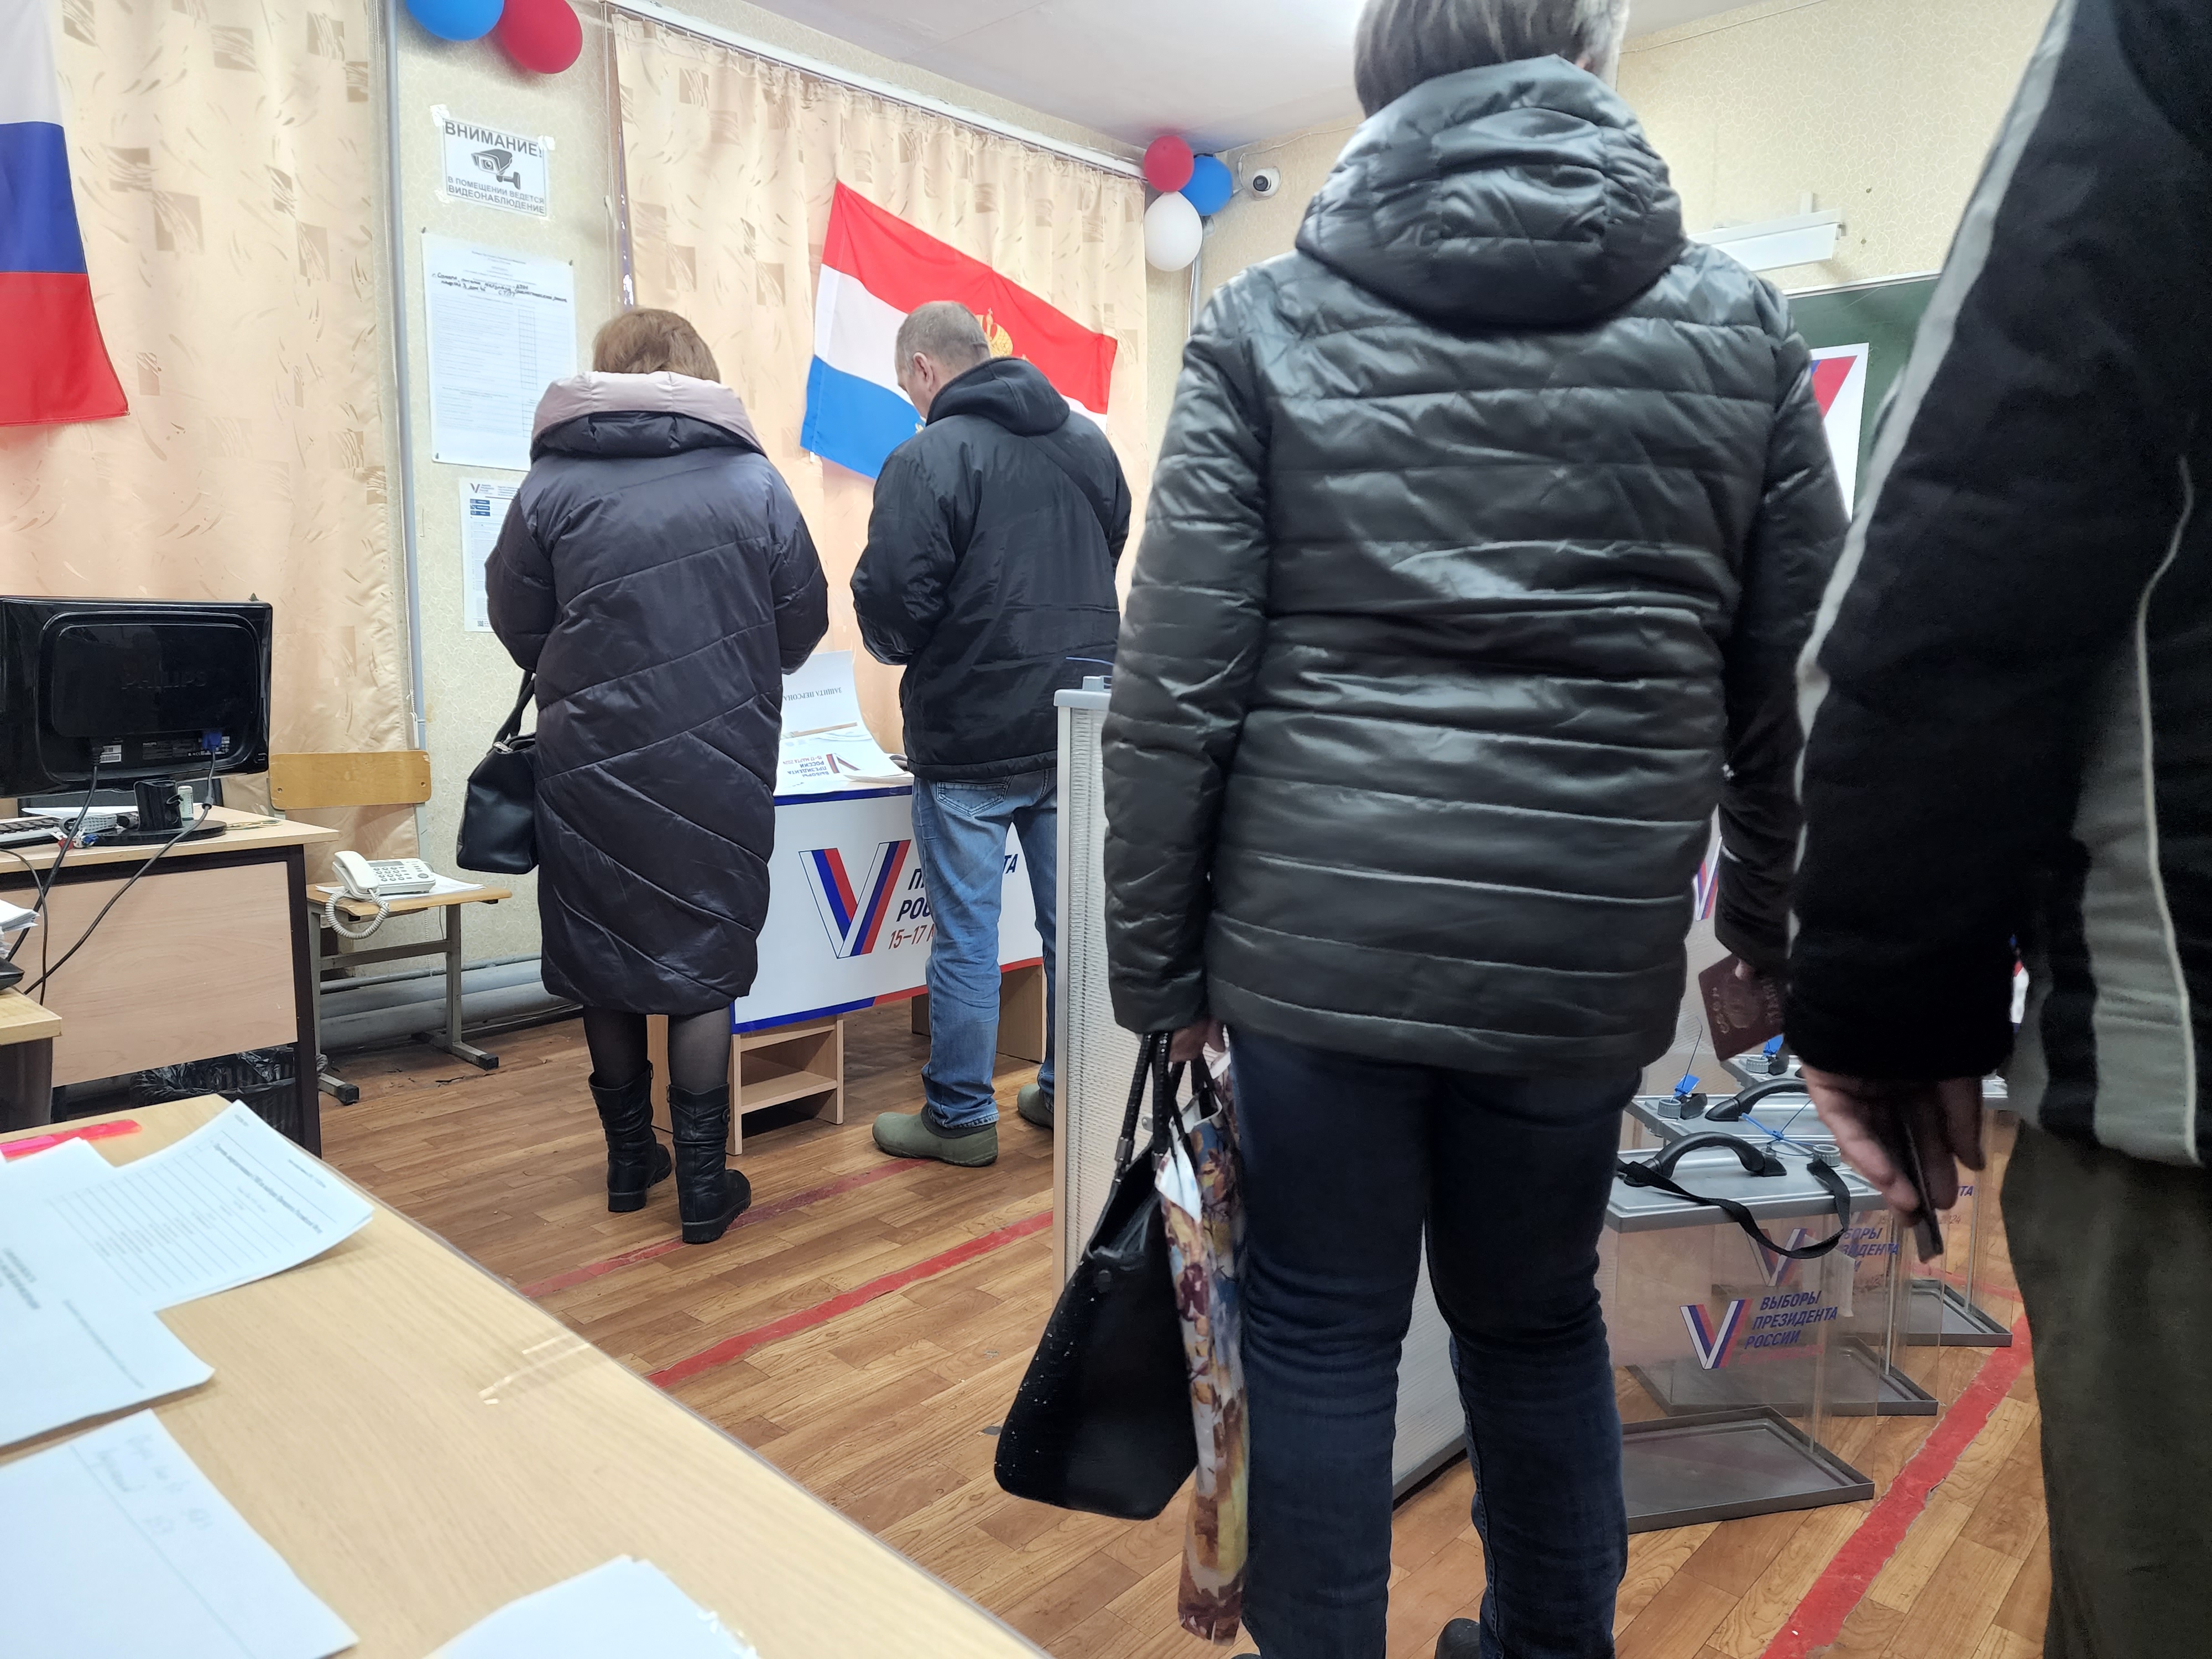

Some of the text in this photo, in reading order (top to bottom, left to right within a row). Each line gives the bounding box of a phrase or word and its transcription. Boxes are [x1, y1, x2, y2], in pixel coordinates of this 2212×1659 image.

[445, 121, 542, 158] ВНИМАНИЕ!
[448, 185, 545, 214] ВИДЕОНАБЛЮДЕНИЕ
[456, 178, 507, 195] ПОМЕЩЕНИИ
[509, 190, 544, 205] ВЕДЕТСЯ
[816, 687, 842, 697] ЗАЩИТА
[1760, 1290, 1822, 1311] ВЫБОРЫ
[1752, 1306, 1838, 1330] ПРЕЗИДЕНТА
[1744, 1329, 1801, 1349] РОССИИ
